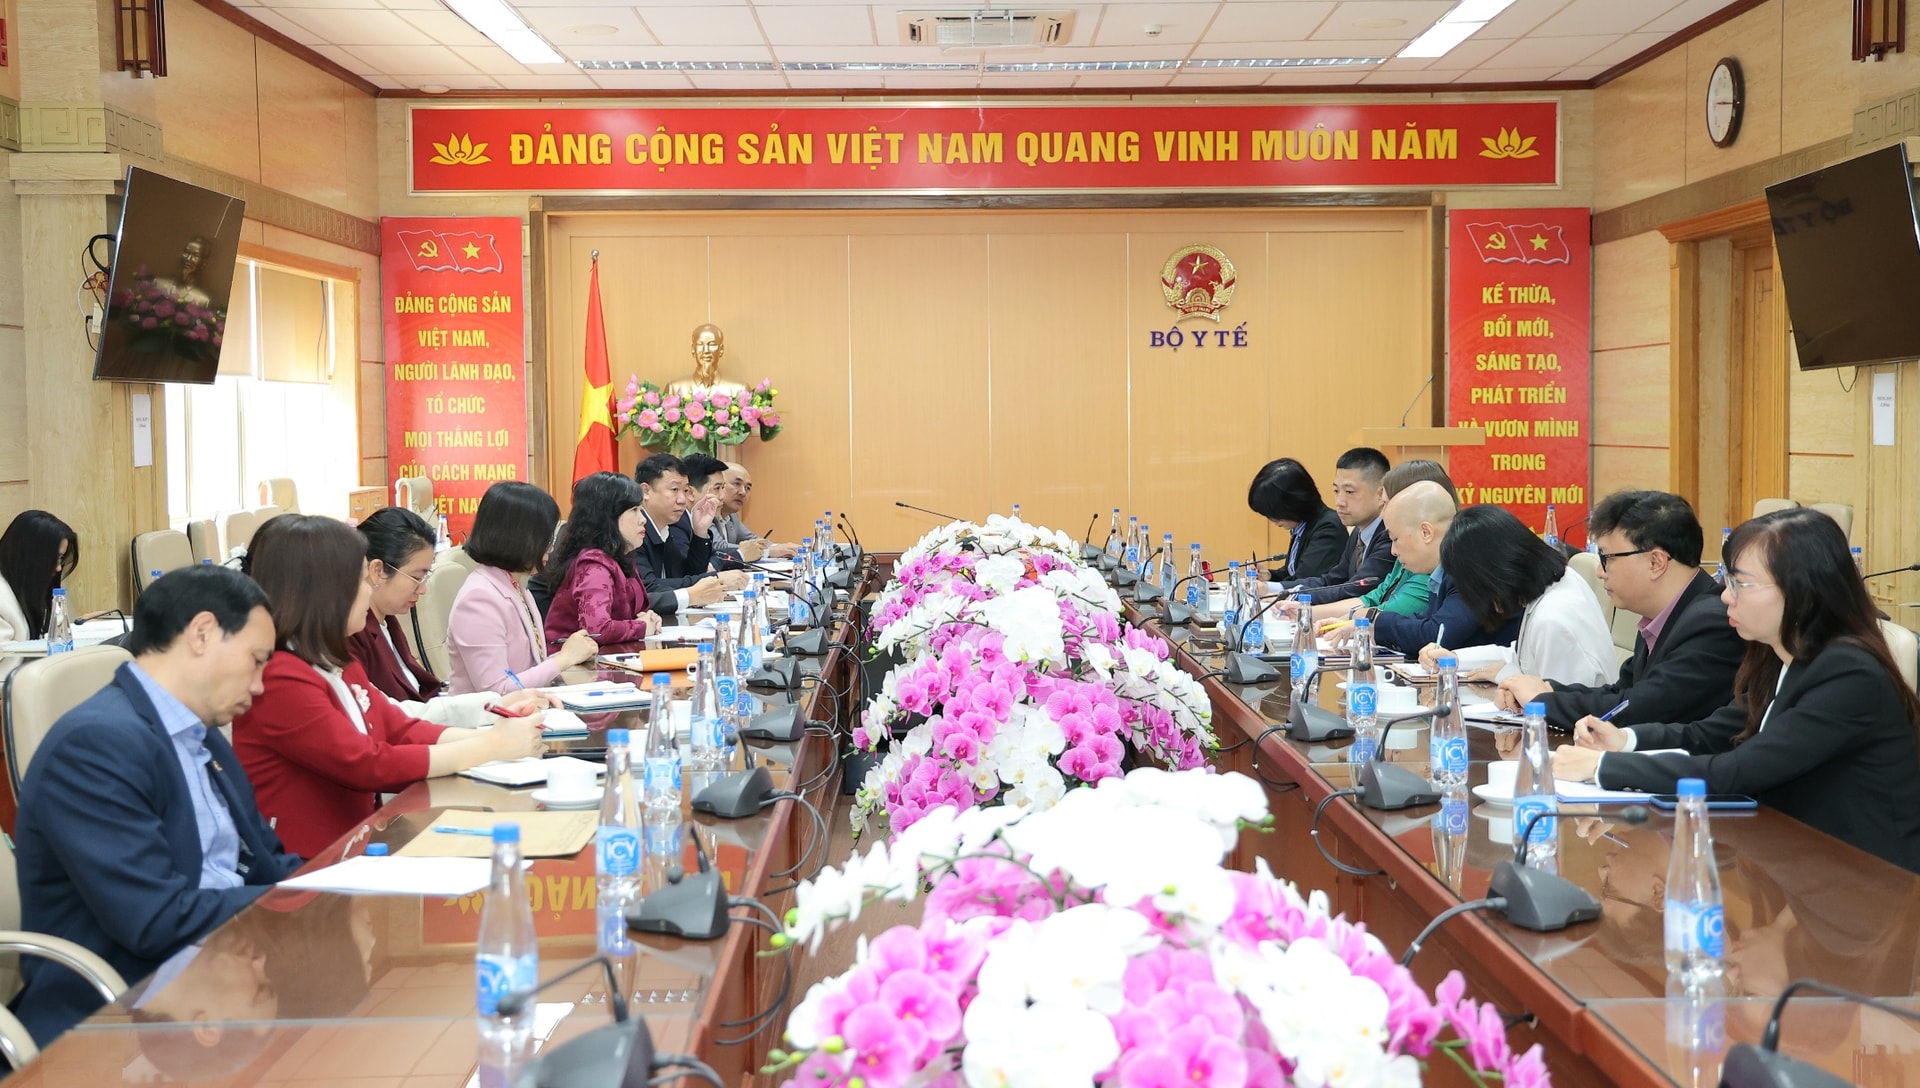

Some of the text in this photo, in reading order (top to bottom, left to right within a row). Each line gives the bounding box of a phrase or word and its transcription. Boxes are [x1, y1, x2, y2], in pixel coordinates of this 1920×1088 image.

[510, 121, 1458, 172] ĐẢNG CỘNG SẢN VIỆT NAM QUANG VINH MUÔN NĂM
[395, 290, 512, 317] ĐẢNG CỘNG SẢN
[1482, 282, 1556, 305] KẾ THỪA,
[1150, 321, 1248, 352] BỘ Y TẾ
[1483, 313, 1555, 339] ĐỔI MỚI,
[418, 327, 490, 351] VIỆT NAM,
[395, 362, 516, 384] NGƯỜI LÃNH ĐẠO,
[1476, 350, 1562, 375] SÁNG TẠO,
[426, 391, 486, 414] TỔ CHỨC
[1471, 380, 1567, 404] PHÁT TRIỂN
[404, 425, 509, 451] MỌI THẮNG LỢI
[1484, 420, 1532, 438] VƯƠN
[1534, 417, 1579, 438] MÌNH
[399, 458, 517, 484] CỦA CÁCH MẠNG
[1491, 453, 1546, 471] TRONG
[1455, 481, 1584, 504] KỶ NGUYÊN MỚI
[458, 497, 482, 514] NA
[1354, 691, 1375, 705] ICY
[1445, 746, 1466, 761] ICY
[606, 839, 638, 860] ICY
[1703, 915, 1724, 938] IC
